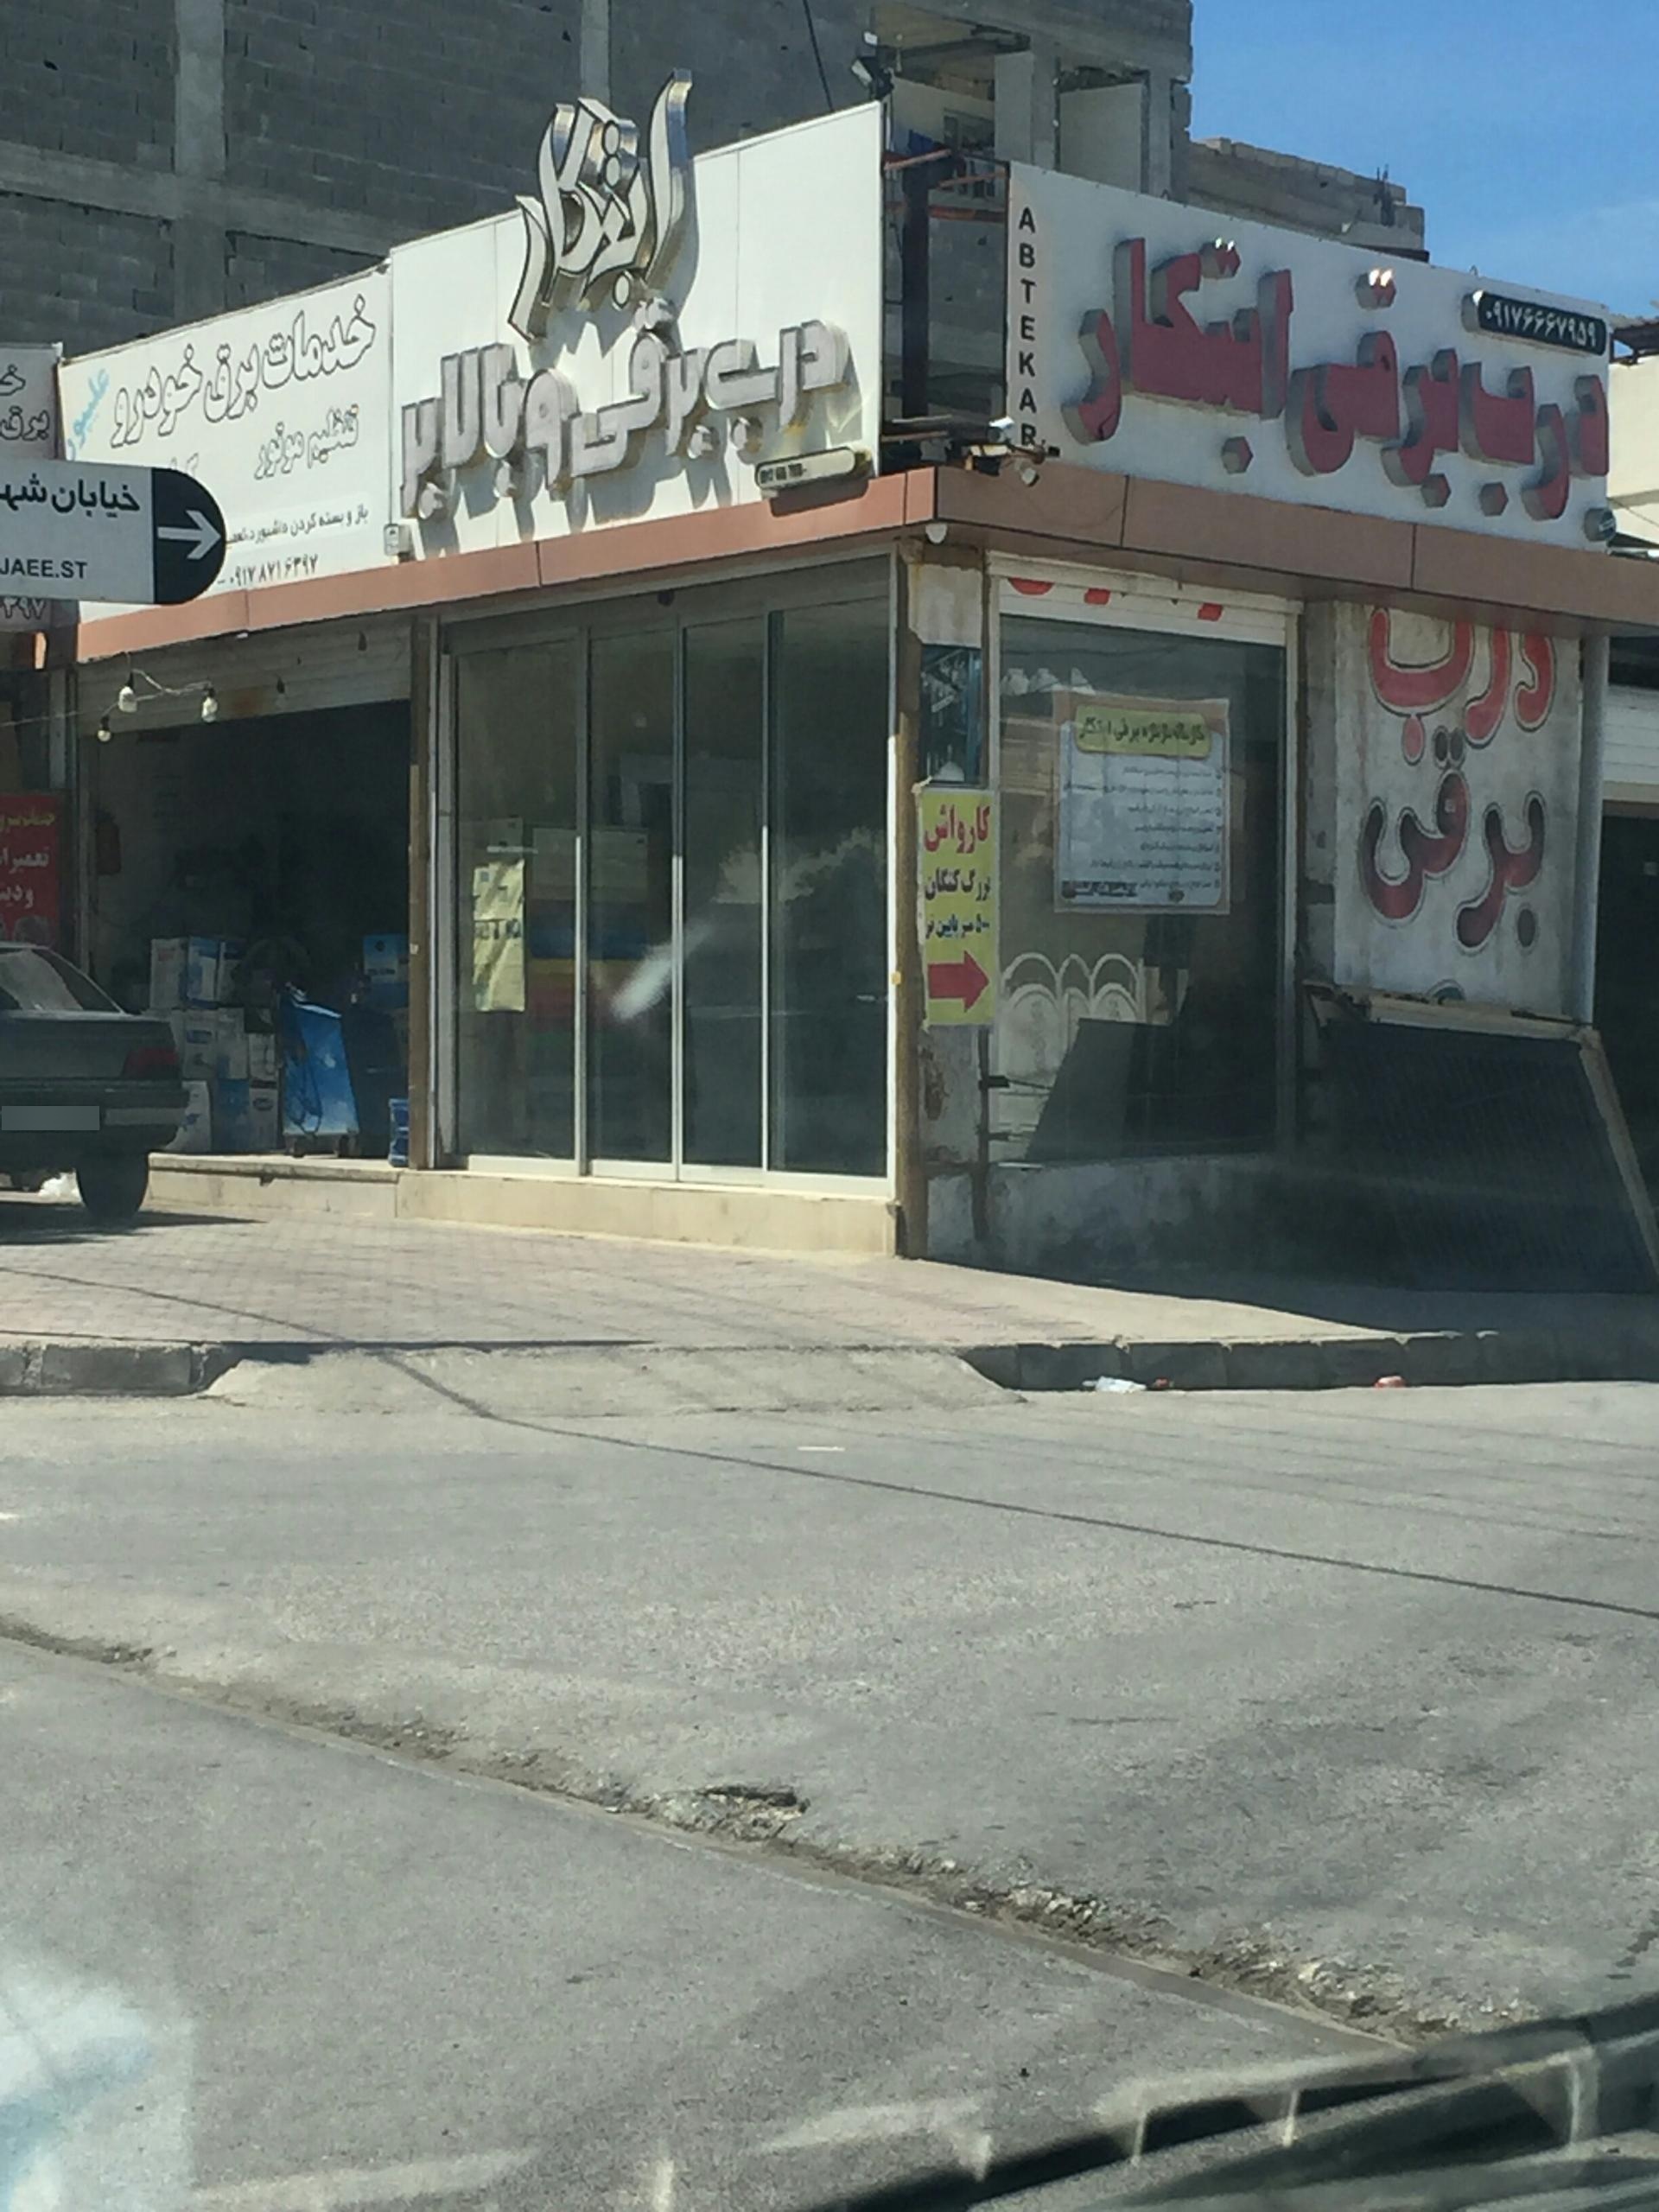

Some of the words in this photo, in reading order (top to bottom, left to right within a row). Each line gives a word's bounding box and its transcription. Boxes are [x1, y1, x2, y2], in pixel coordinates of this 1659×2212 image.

[508, 67, 692, 343] ابتکار
[204, 341, 259, 423] برق
[262, 294, 377, 389] خدمات
[704, 318, 849, 451] درب
[1018, 207, 1036, 447] ABTEKAR
[1061, 237, 1292, 474] ابتکار
[111, 343, 203, 448] خودرو
[308, 403, 359, 469] تنظیم
[401, 342, 524, 518] بالابر
[569, 296, 721, 479] برقی
[1285, 268, 1458, 508] برقی
[1459, 362, 1609, 520] درب
[0, 473, 47, 512] شه
[51, 478, 140, 518] خیابان
[254, 421, 304, 480] موتور
[925, 804, 990, 854] کارواش
